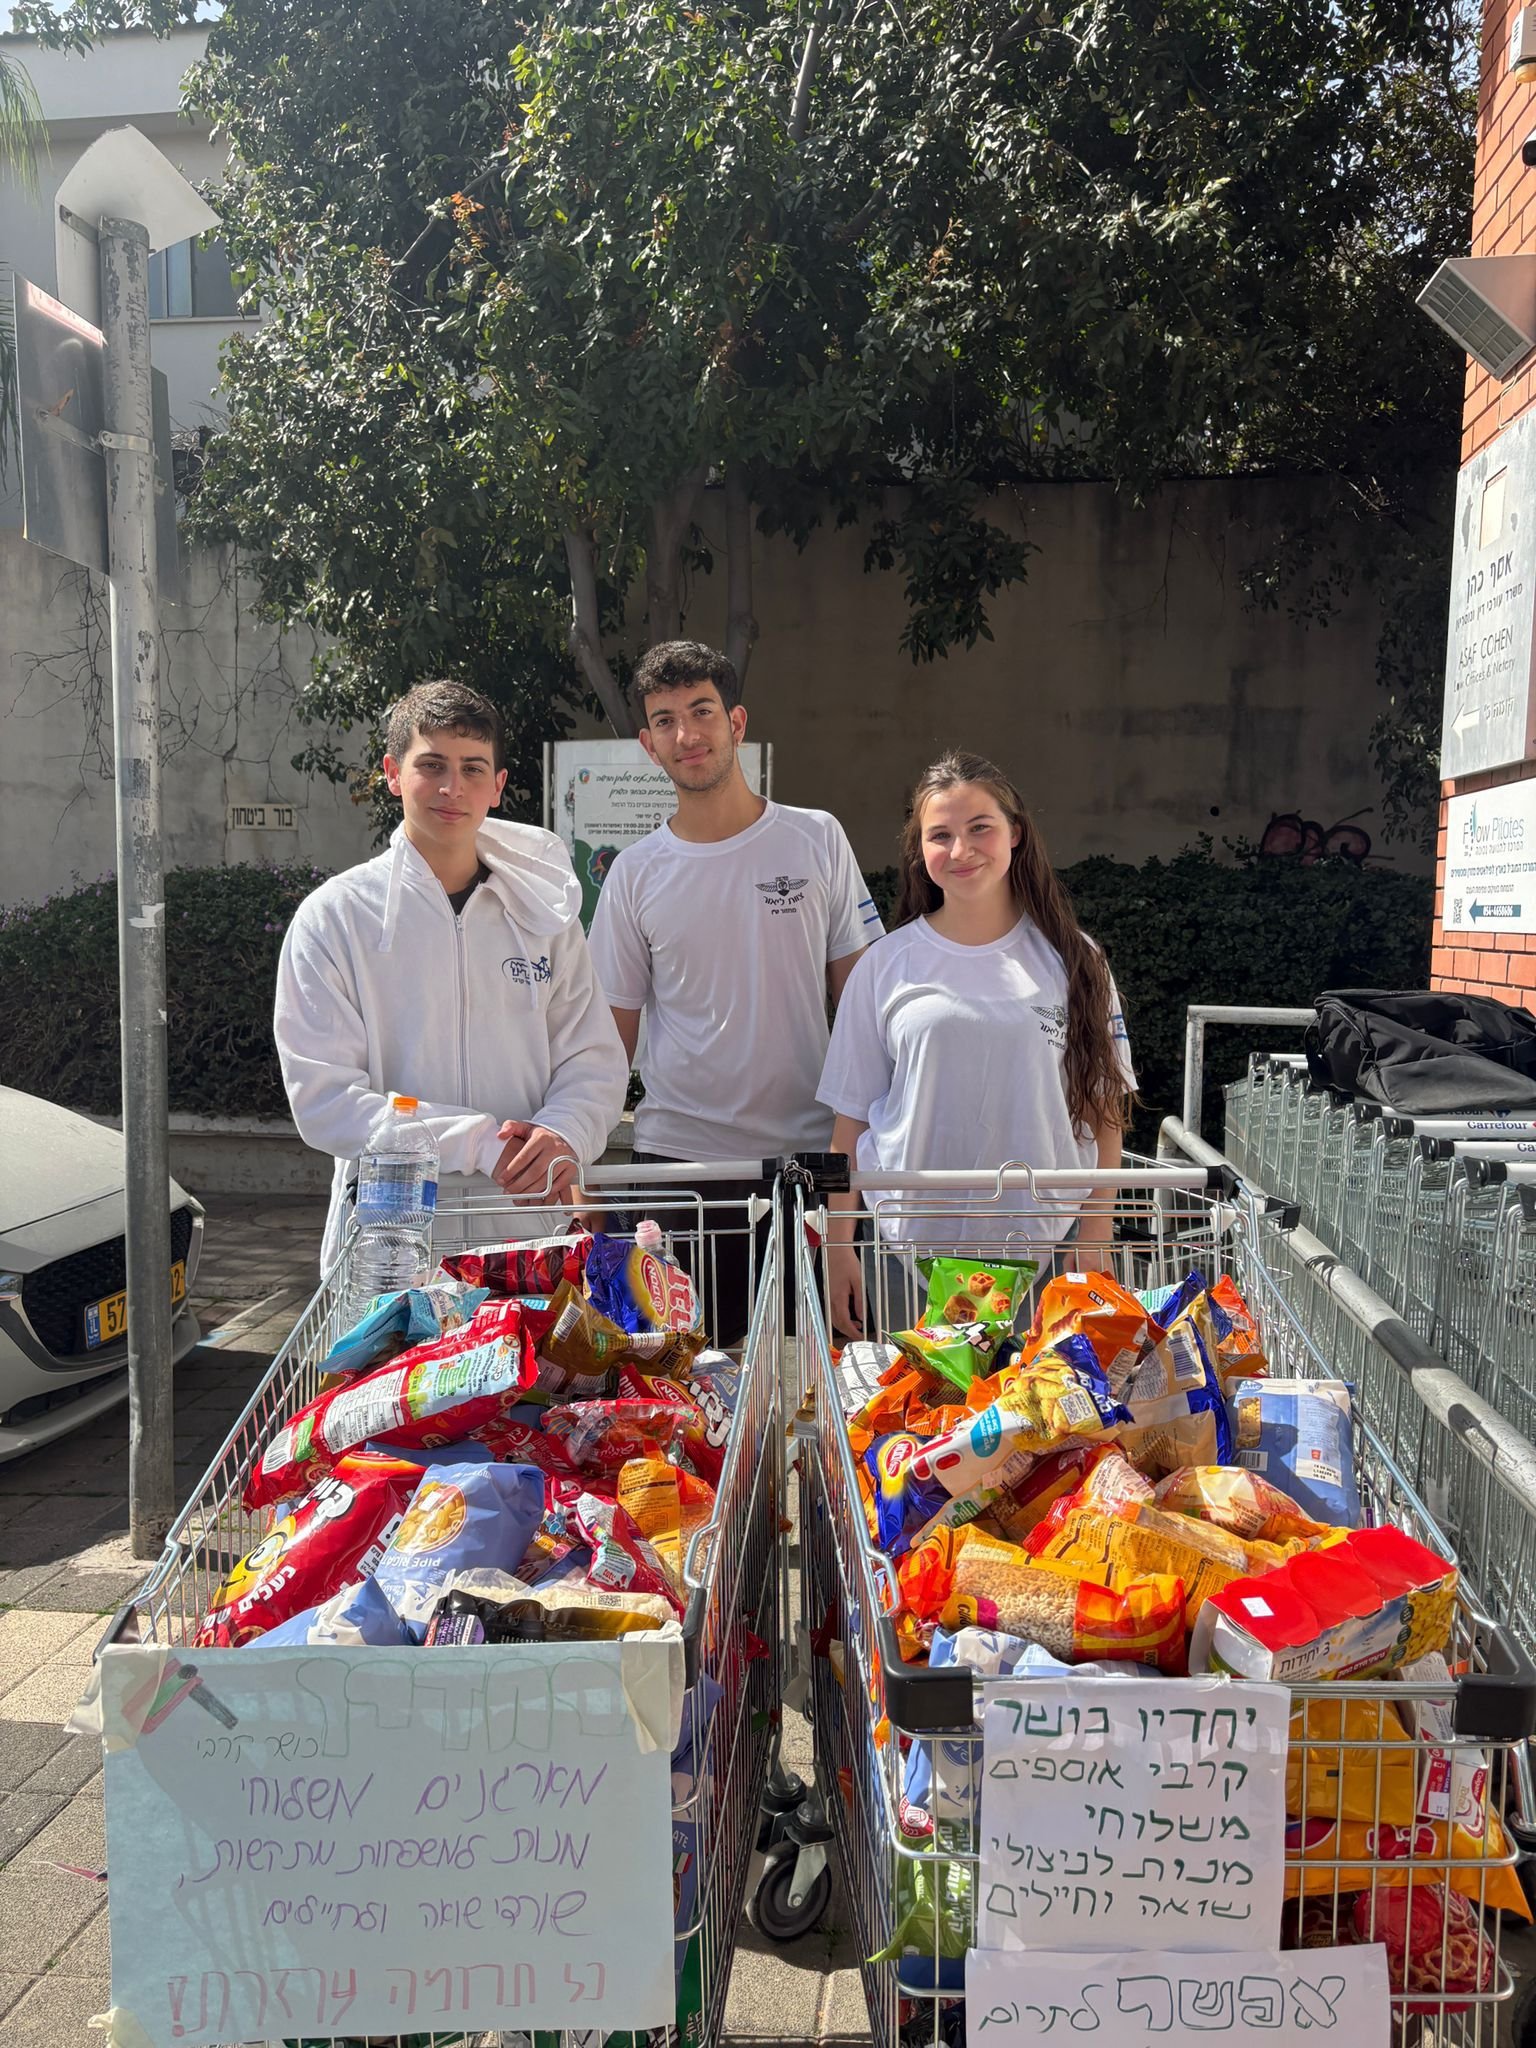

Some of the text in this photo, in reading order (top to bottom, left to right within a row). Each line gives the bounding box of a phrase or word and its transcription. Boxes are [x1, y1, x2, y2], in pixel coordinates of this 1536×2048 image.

[1467, 550, 1513, 603] אסף כהן
[1480, 624, 1513, 659] COHEN
[232, 808, 293, 830] בור ביטחון
[1467, 1120, 1528, 1130] Carrefour
[380, 1555, 441, 1568] PIPE RIGAT
[237, 1565, 296, 1614] כעכים
[1279, 1646, 1322, 1674] יחידות
[1322, 1641, 1331, 1656] 3
[994, 1700, 1257, 1748] יחדיו כושר
[197, 1734, 254, 1763] קרבי
[241, 1762, 608, 1823] מארגנים משלוחי
[989, 1756, 1249, 1801] קרבי אוספים
[1474, 1770, 1484, 1798] Colgate
[1084, 1804, 1251, 1841] משלוחי
[336, 1834, 486, 1875] למשפחות
[492, 1827, 589, 1870] מנות
[991, 1833, 1254, 1886] מנות לניצולי
[418, 1897, 483, 1931] שואה
[495, 1890, 594, 1937] שורדי
[986, 1880, 1252, 1919] שואה וחיילים
[386, 1963, 535, 2014] תרומה
[564, 1962, 606, 2003] כל
[978, 1975, 1346, 2032] אפשר לתרום
